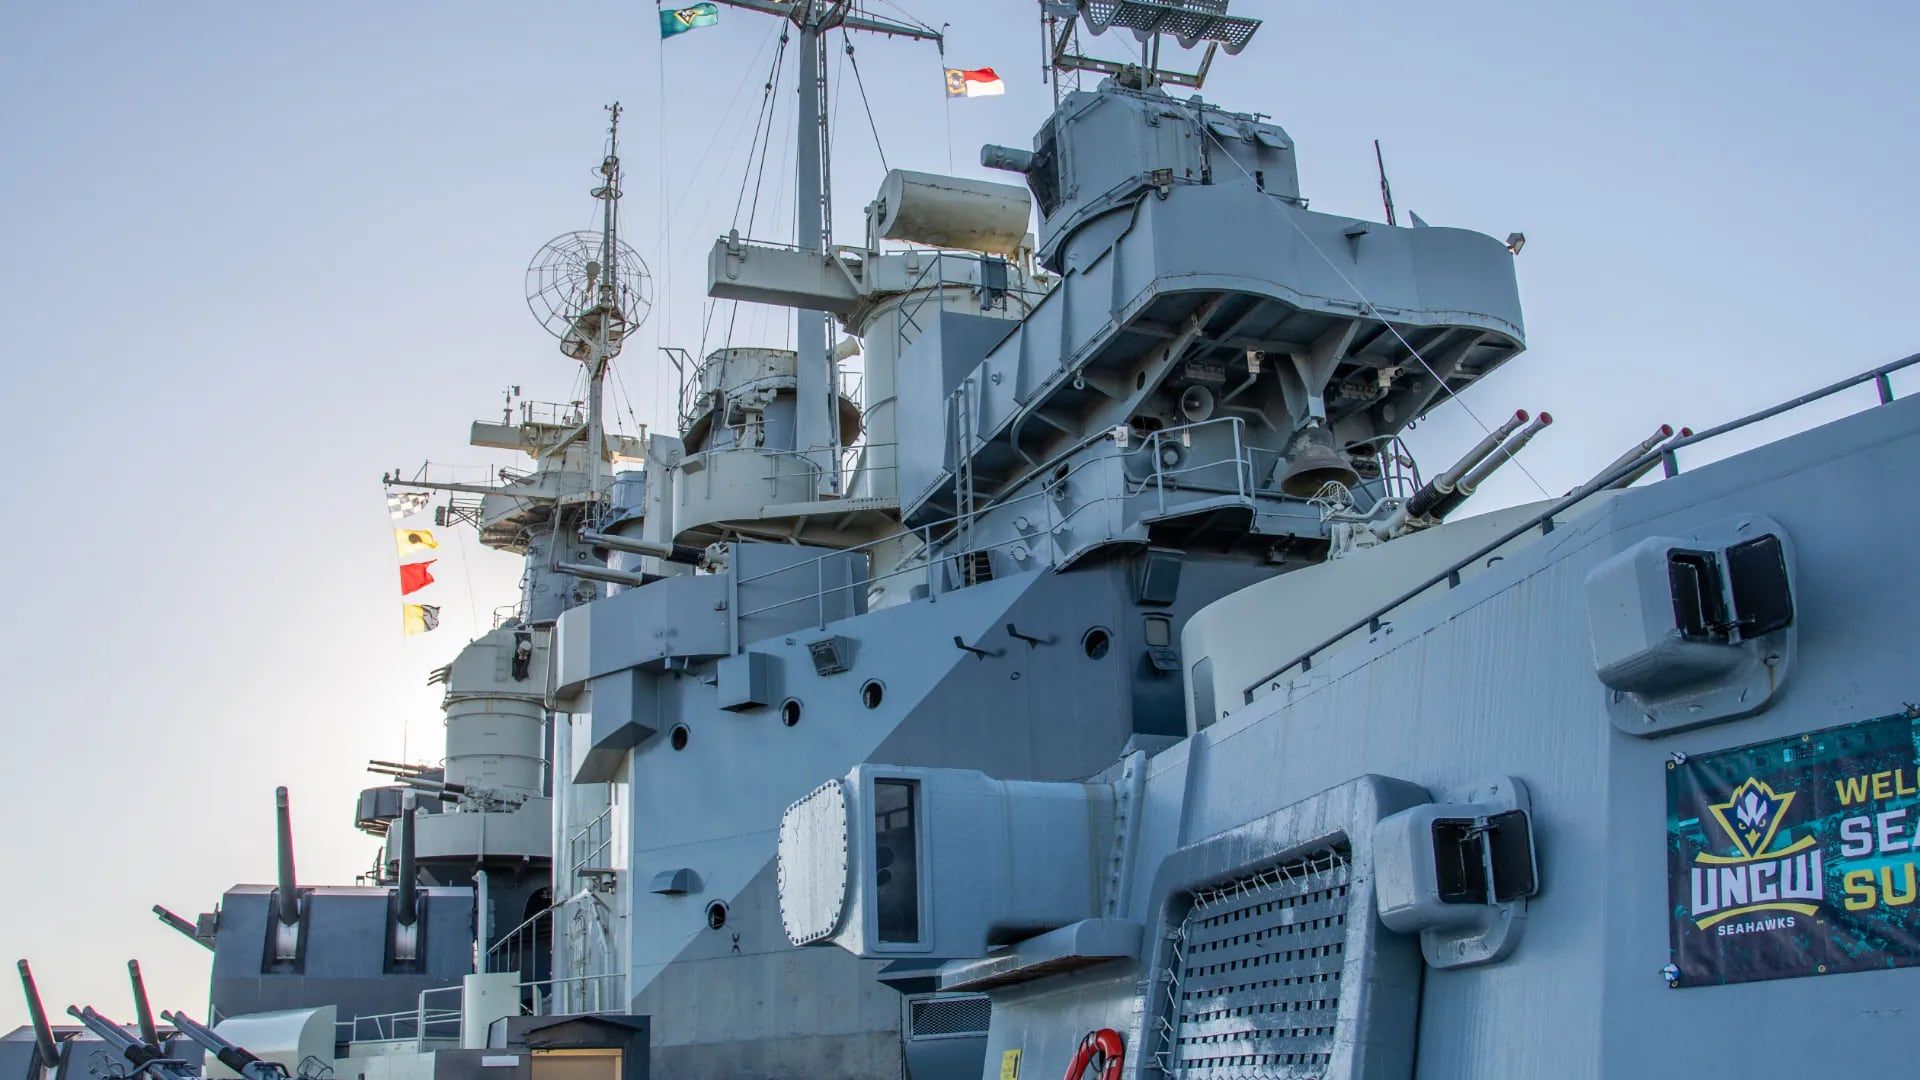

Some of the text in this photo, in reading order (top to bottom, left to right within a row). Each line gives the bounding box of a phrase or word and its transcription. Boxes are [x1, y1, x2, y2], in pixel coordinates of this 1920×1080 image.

[1835, 768, 1920, 806] WEL
[1840, 808, 1920, 857] SE
[1691, 849, 1823, 916] UNCW
[1718, 917, 1795, 936] SEAHAWKS
